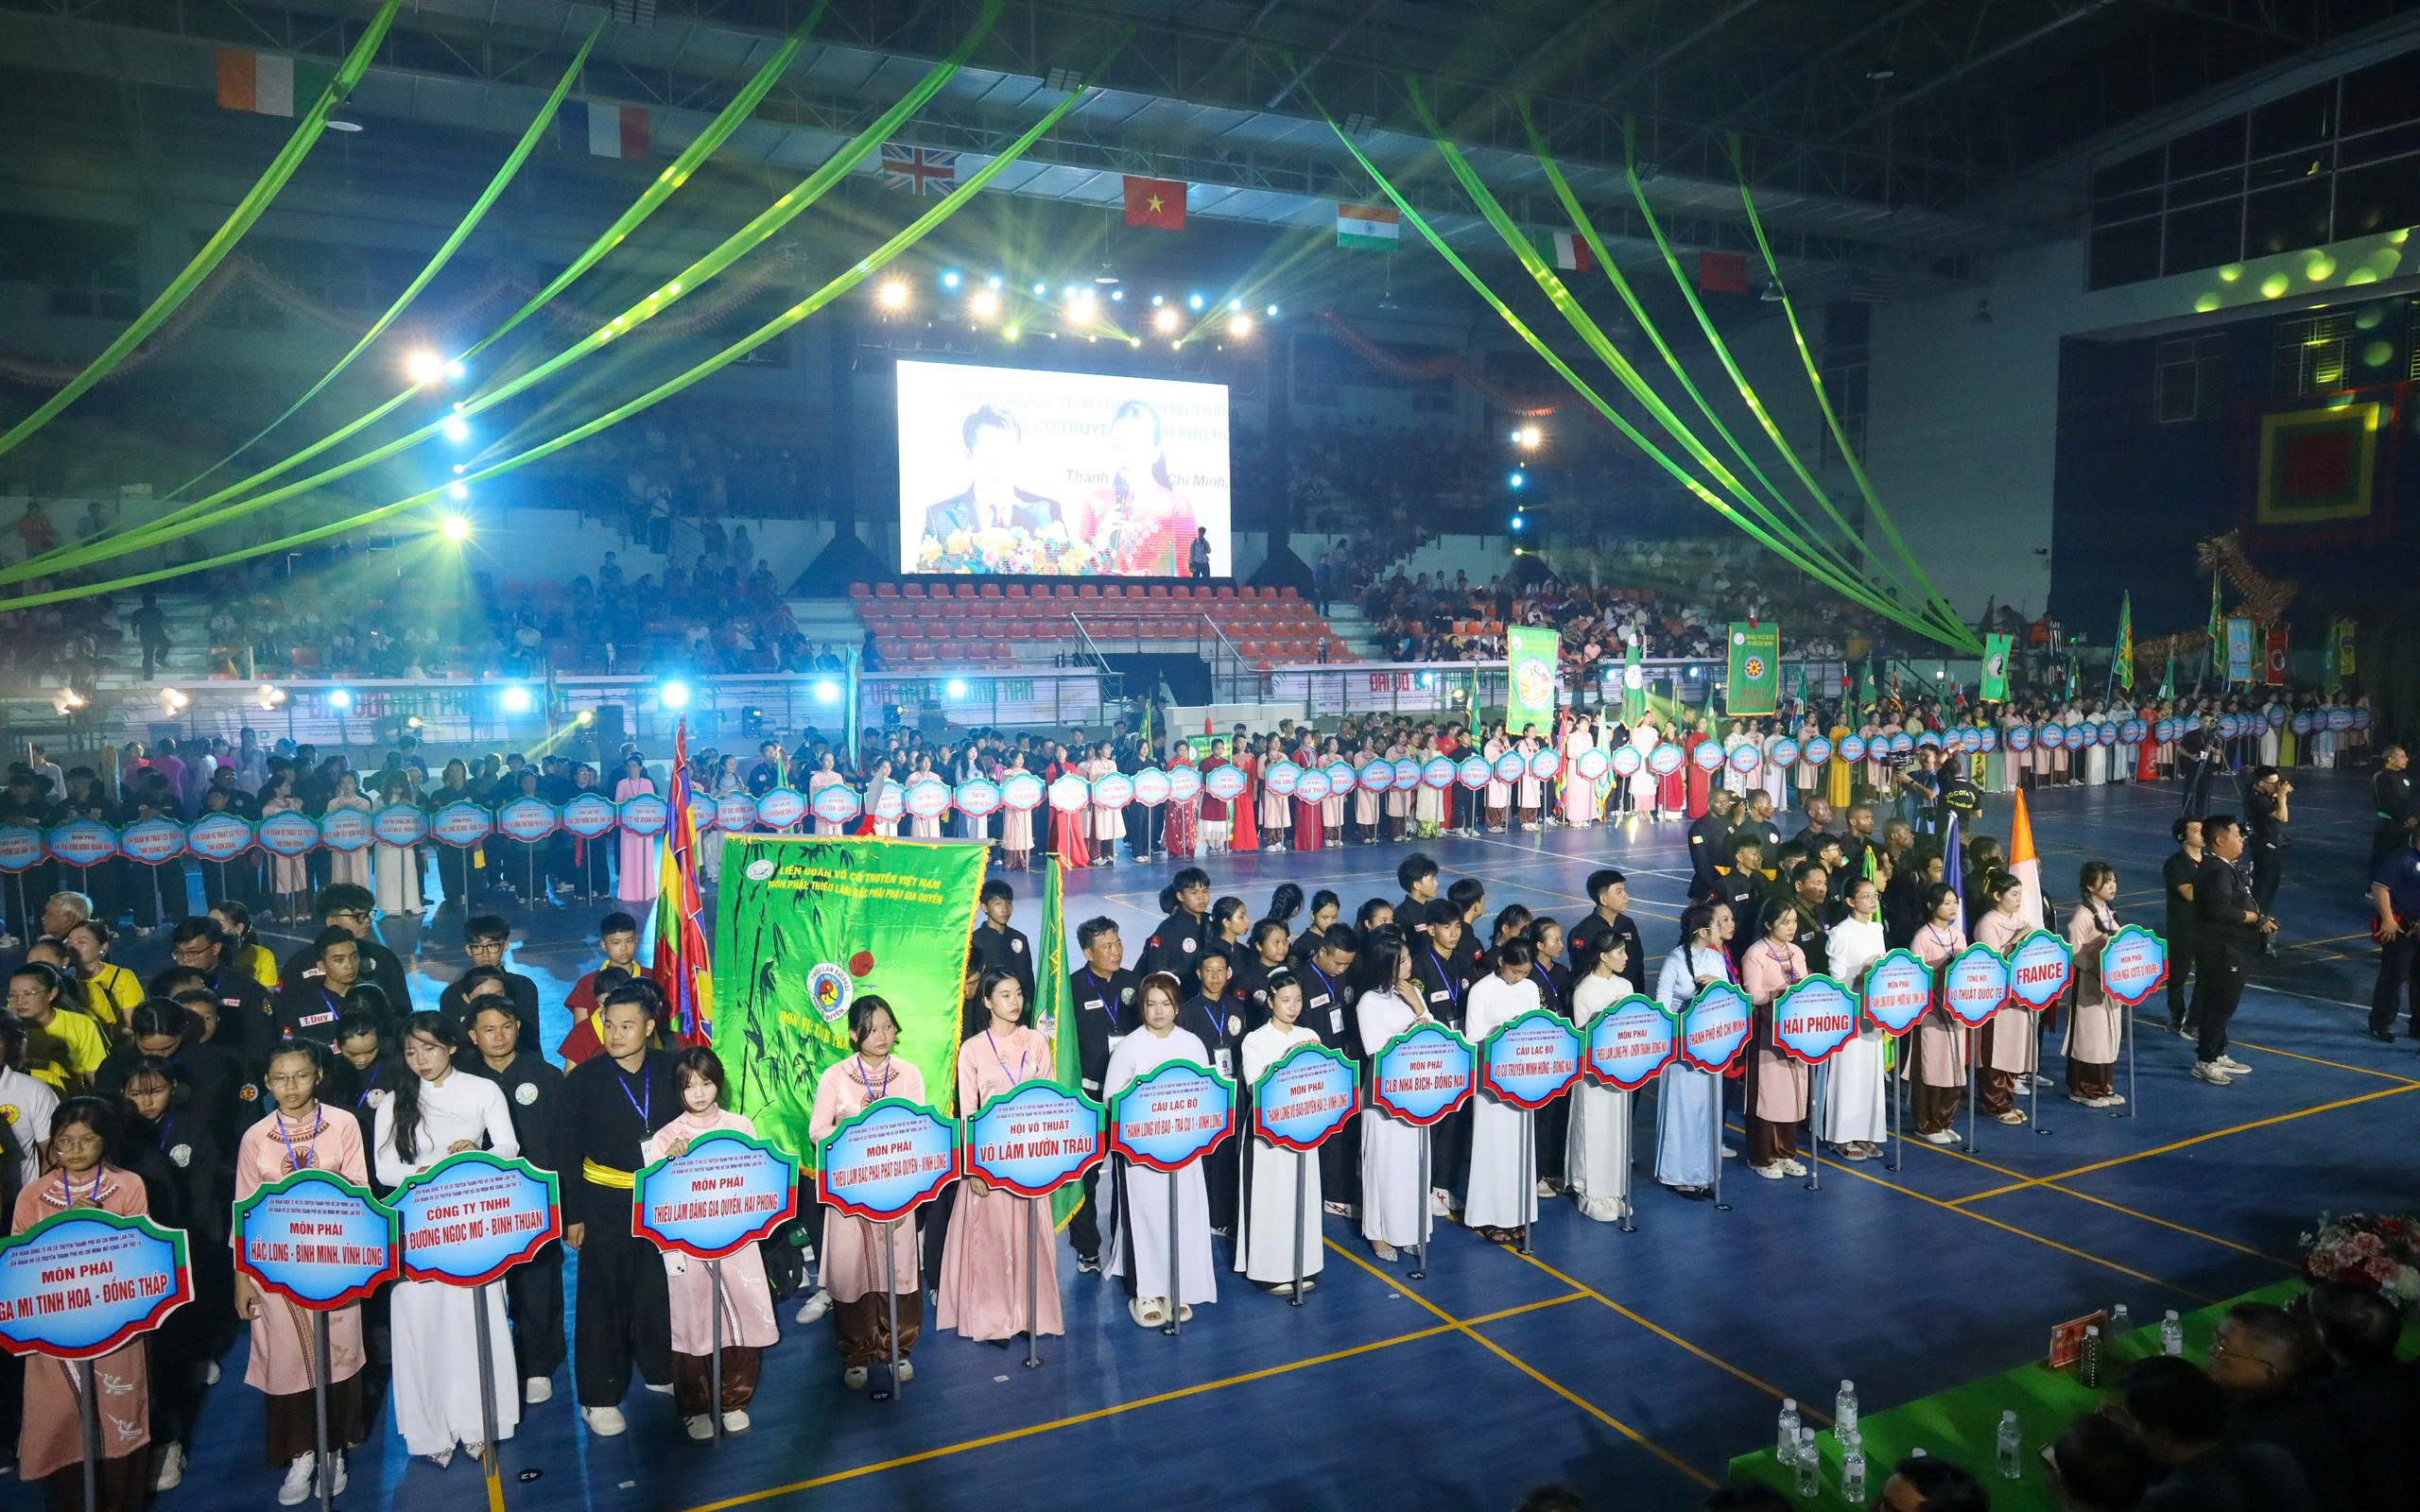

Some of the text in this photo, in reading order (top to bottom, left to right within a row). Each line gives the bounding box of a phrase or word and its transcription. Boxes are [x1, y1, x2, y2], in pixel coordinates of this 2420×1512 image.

[2017, 962, 2063, 986] FRANCE
[1959, 987, 1977, 1002] THUẬT
[1784, 1012, 1849, 1035] HẢI PHÒNG
[1617, 1028, 1647, 1040] MÔN PHÁI
[1516, 1044, 1553, 1057] CÂU LẠC BỘ
[1410, 1059, 1443, 1071] MÔN PHÁI
[1290, 1080, 1324, 1096] MÔN PHÁI
[1385, 1079, 1397, 1093] CLB
[1399, 1077, 1412, 1091] NHA
[1434, 1072, 1452, 1089] ĐỒNG
[1454, 1074, 1465, 1088] NAI
[1151, 1097, 1198, 1112] CÂU LẠC BỘ
[1010, 1119, 1070, 1137] HỘI VÕ THUẬT
[867, 1140, 912, 1159] MÔN PHÁI
[980, 1132, 1092, 1162] VÕ LÂM VƯỜN TRẦU
[934, 1154, 946, 1170] LONG
[691, 1176, 744, 1192] MÔN PHÁI
[426, 1197, 510, 1222] CÔNG TY TNHH
[654, 1199, 672, 1224] THIẾU
[674, 1200, 687, 1222] LÂM
[689, 1198, 707, 1224] ĐẶNG
[709, 1201, 719, 1217] GIA
[744, 1191, 755, 1212] HẢI
[756, 1191, 778, 1211] PHÒNG
[289, 1221, 343, 1236] MÔN PHÁI
[409, 1209, 543, 1251] ĐƯỜNG NGỌC MƠ BÌNH THUẬN
[251, 1236, 267, 1262] HẮC
[268, 1243, 289, 1263] LONG
[296, 1241, 315, 1263] BÌNH
[342, 1243, 360, 1264] VĨNH
[362, 1247, 383, 1266] LONG
[42, 1260, 112, 1284] MÔN PHÁI
[17, 1292, 33, 1317] MI
[36, 1291, 64, 1314] TINH
[68, 1287, 92, 1310] HOA
[102, 1276, 135, 1303] ĐỒNG
[138, 1271, 168, 1297] THÁP
